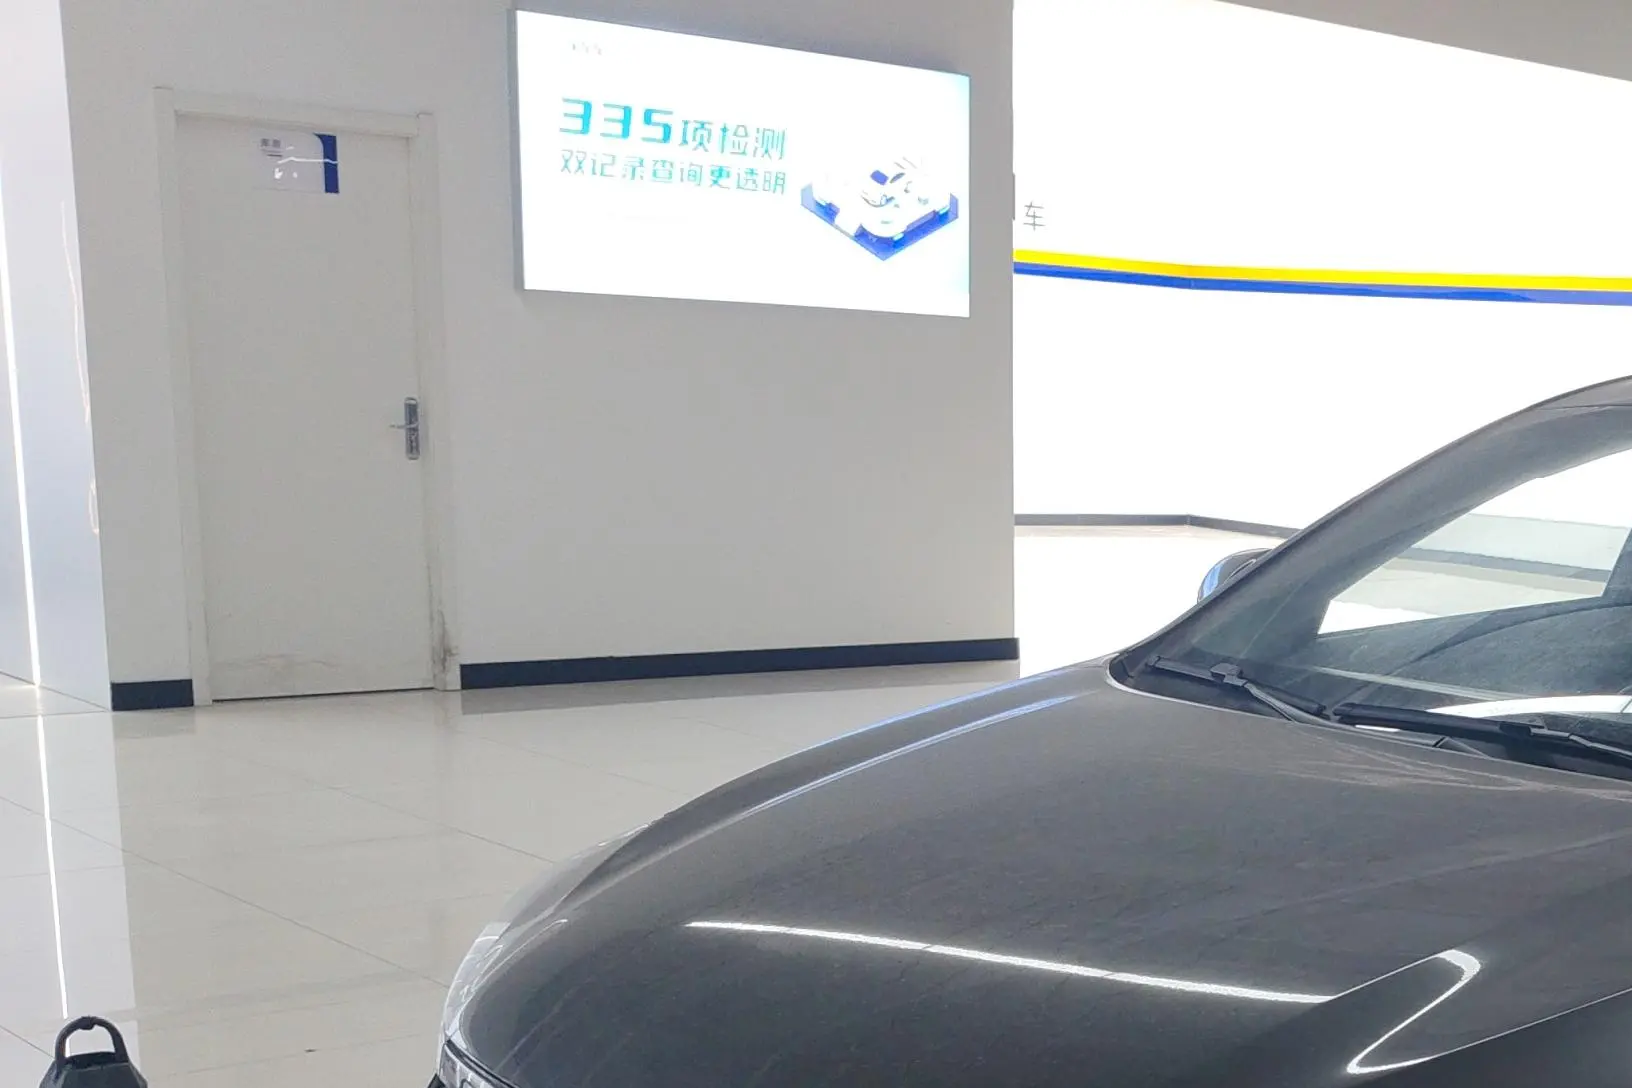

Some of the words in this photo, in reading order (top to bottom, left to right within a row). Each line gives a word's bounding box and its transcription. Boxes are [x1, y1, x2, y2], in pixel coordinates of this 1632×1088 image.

[560, 97, 787, 161] 335项检测
[560, 148, 787, 195] 双记录查询更透明
